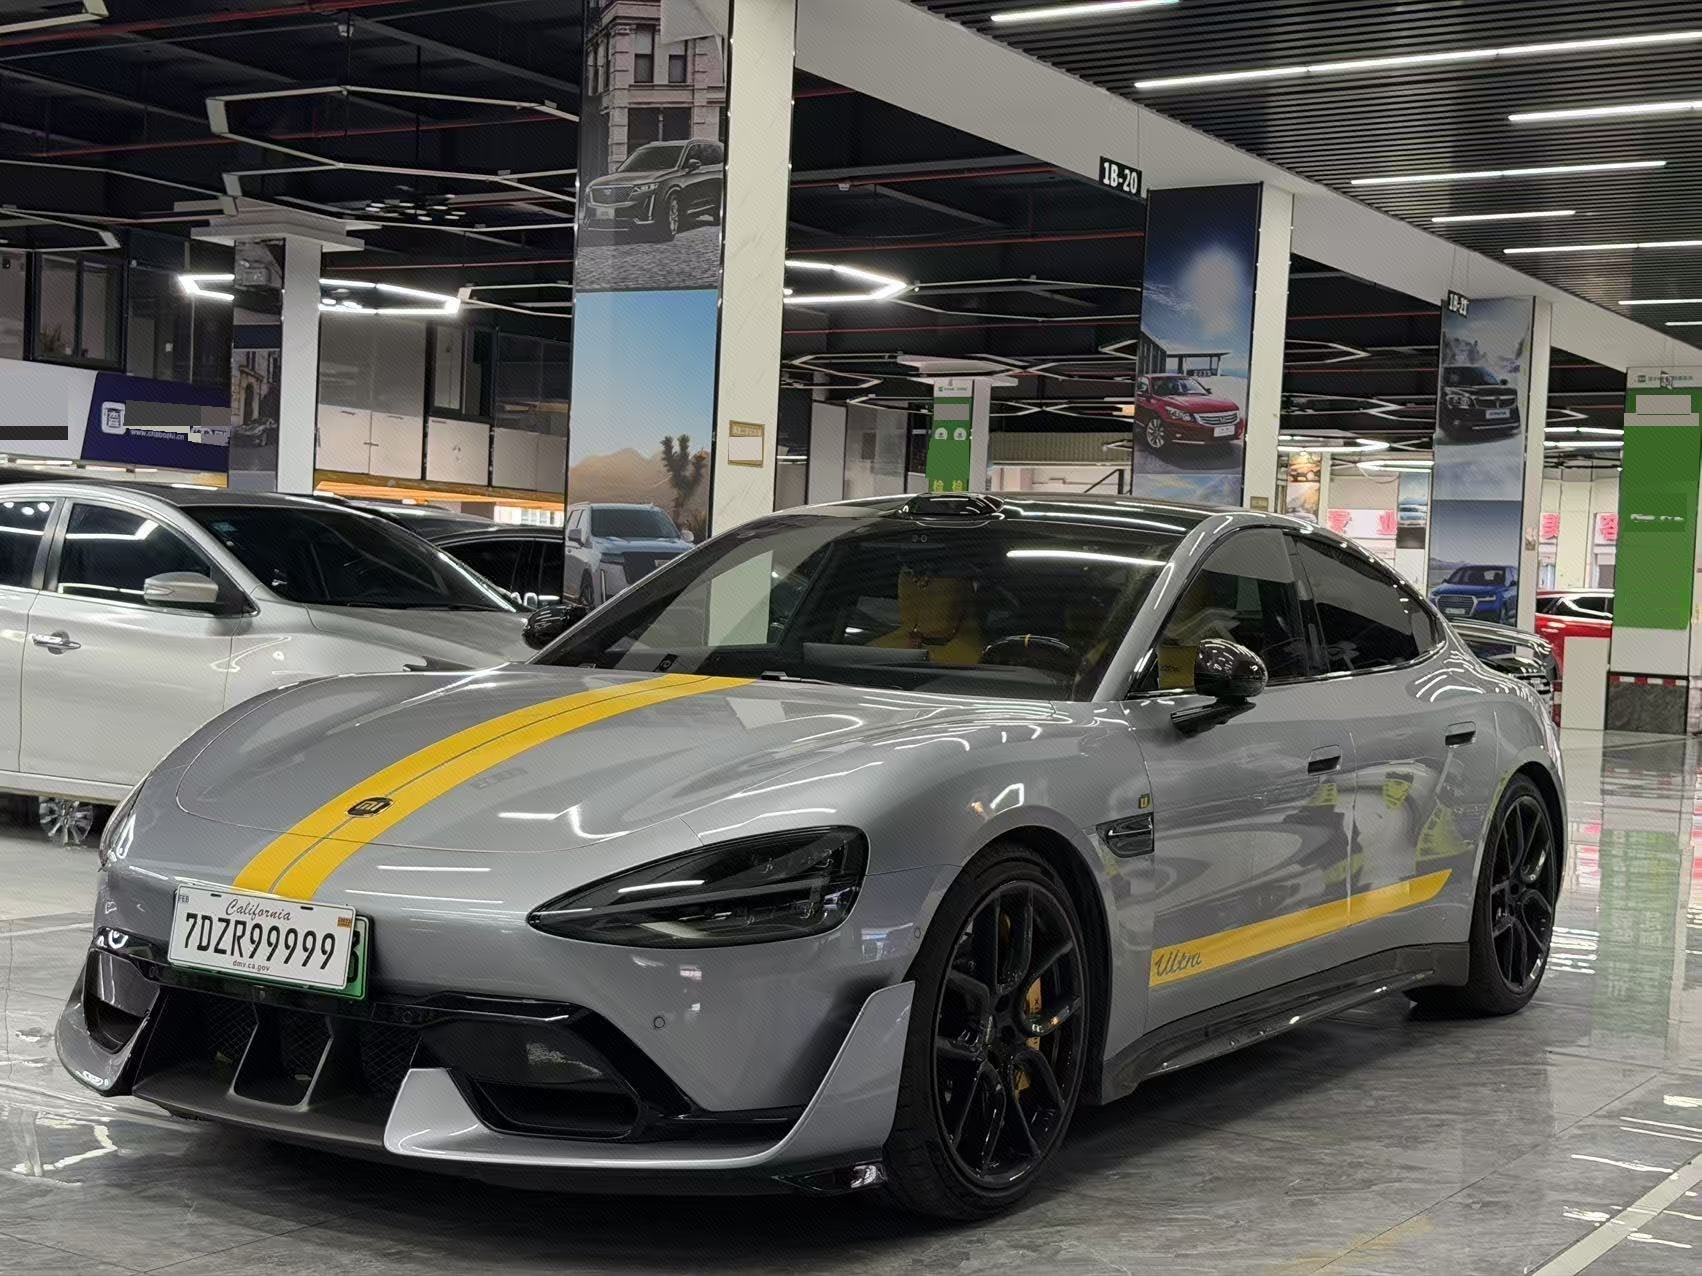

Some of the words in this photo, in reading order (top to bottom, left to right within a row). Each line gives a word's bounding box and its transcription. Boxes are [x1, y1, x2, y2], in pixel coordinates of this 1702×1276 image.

[1103, 161, 1138, 194] 1B-20
[225, 898, 293, 922] California
[184, 911, 336, 970] 7DZR99999
[232, 959, 271, 973] dmv.ca.gov
[1154, 949, 1202, 977] Ultra
